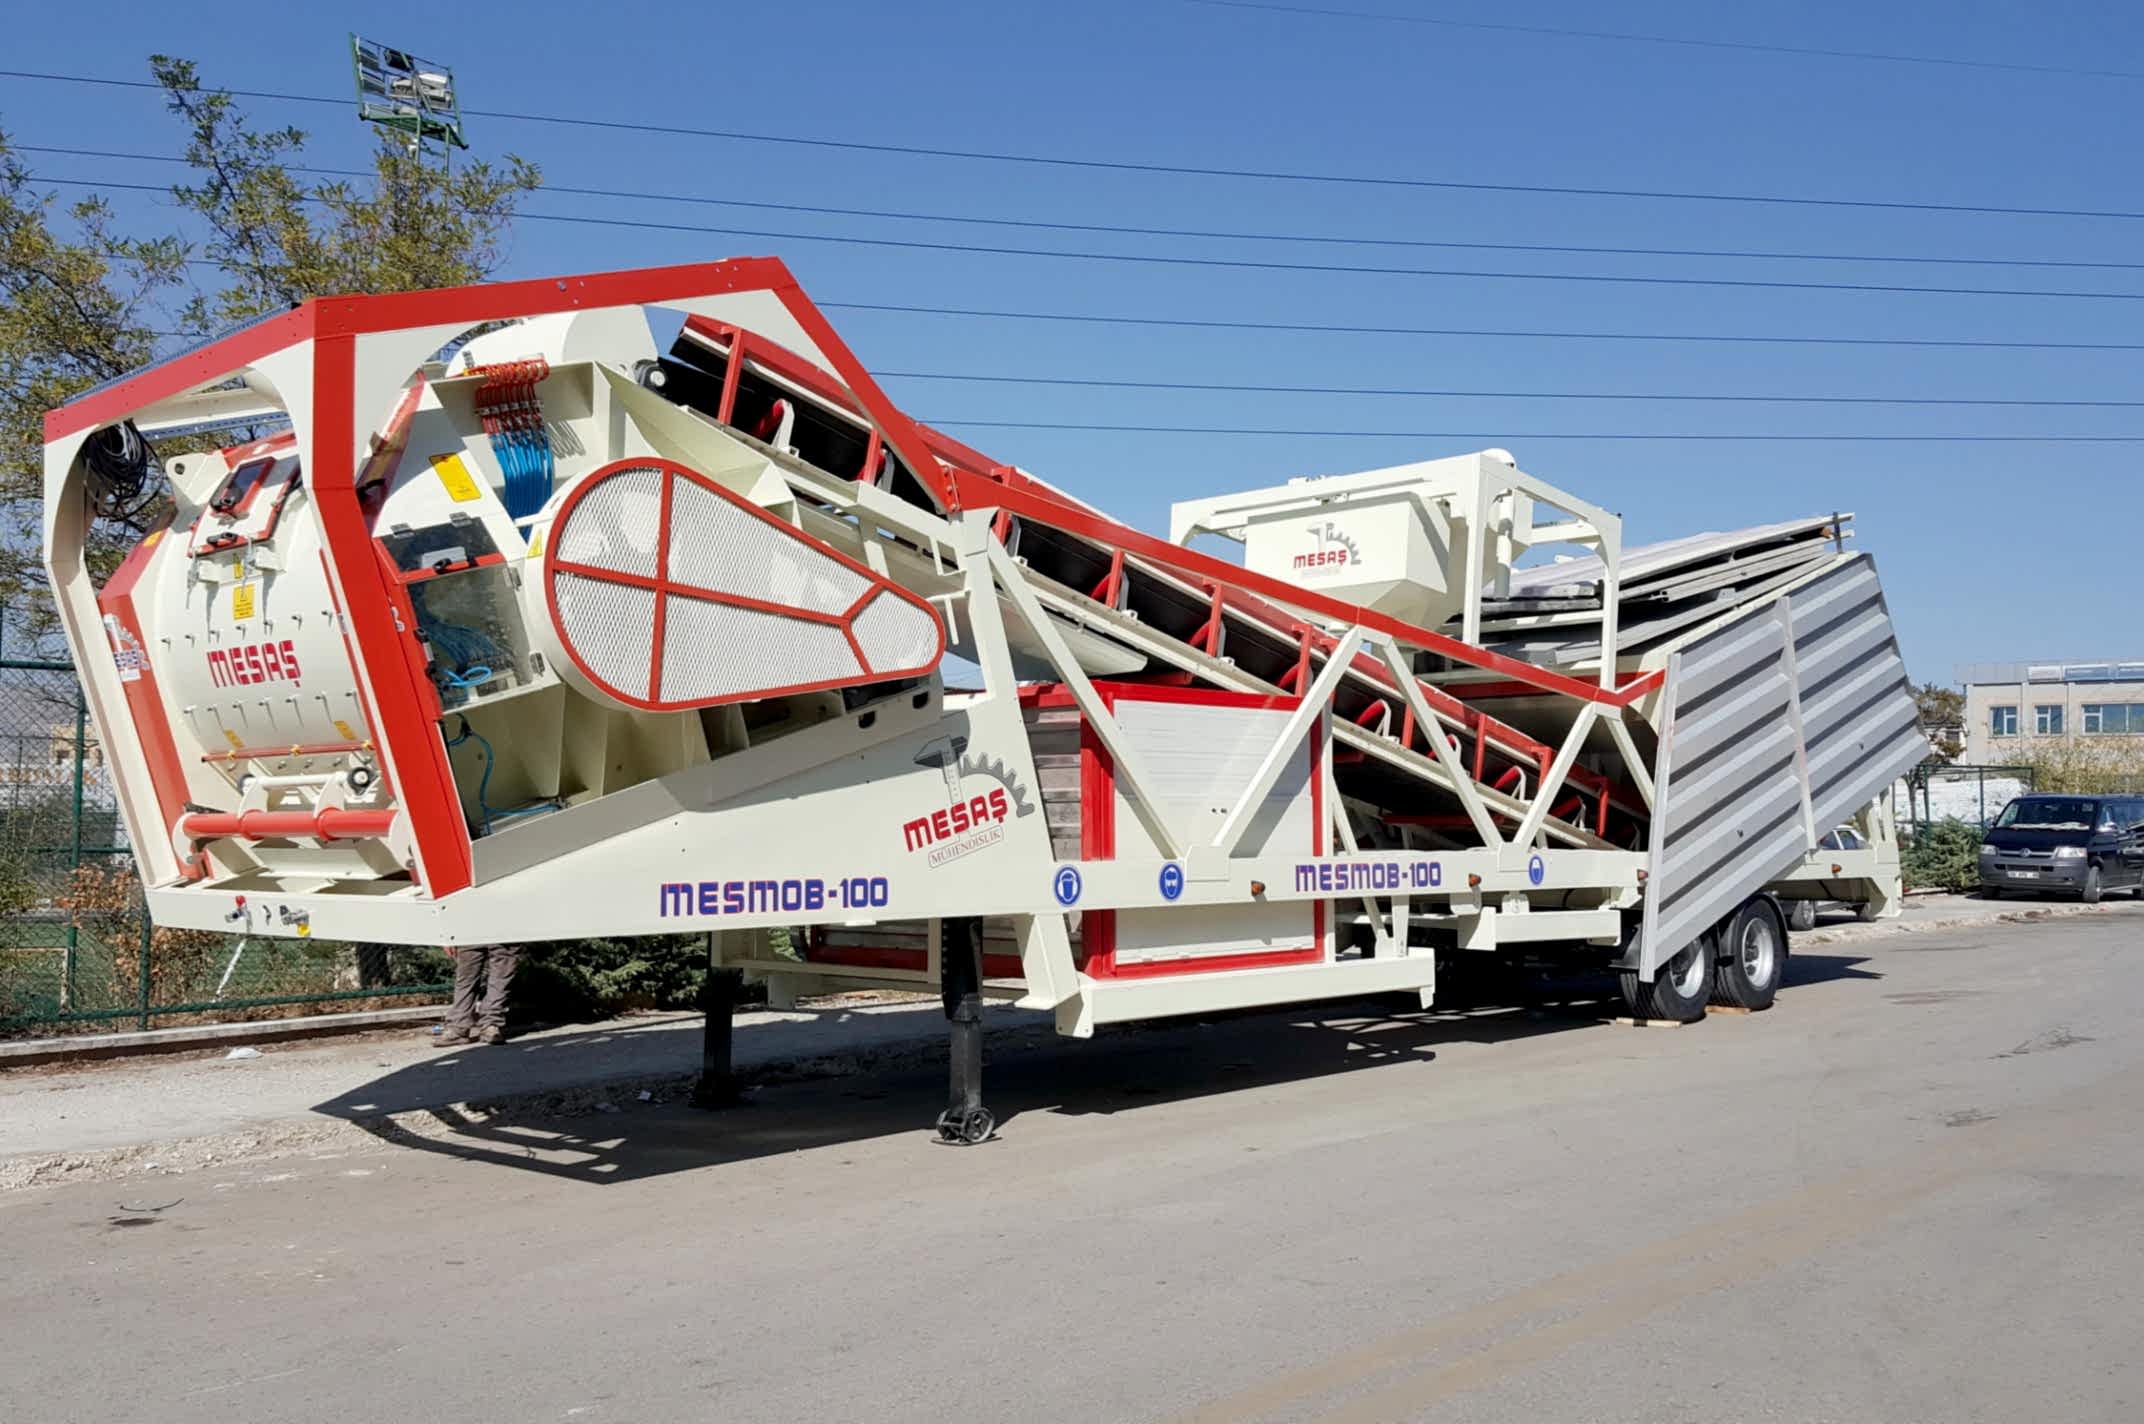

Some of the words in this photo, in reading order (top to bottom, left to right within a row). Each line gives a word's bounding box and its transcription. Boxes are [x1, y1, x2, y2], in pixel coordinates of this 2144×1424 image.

[1294, 549, 1347, 568] MESAŞ
[206, 640, 301, 688] MESAŞ
[903, 787, 1008, 852] MESAŞ
[660, 876, 889, 917] MESMOB-100
[1295, 861, 1442, 893] MESMOB-100
